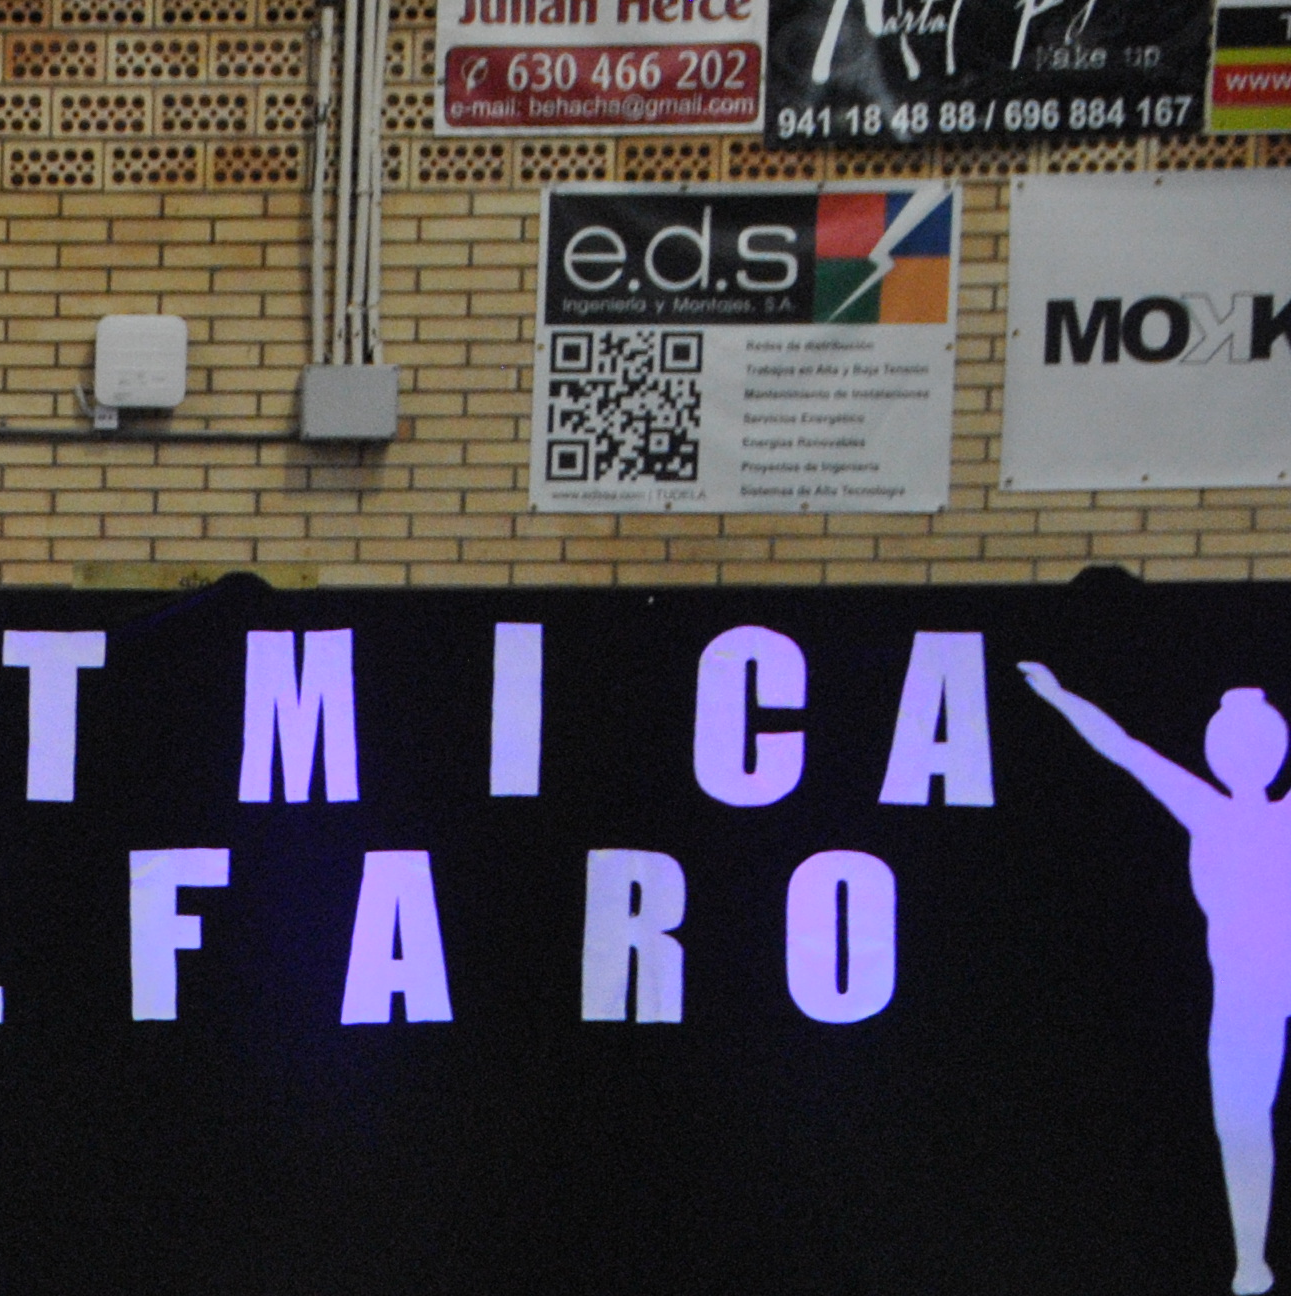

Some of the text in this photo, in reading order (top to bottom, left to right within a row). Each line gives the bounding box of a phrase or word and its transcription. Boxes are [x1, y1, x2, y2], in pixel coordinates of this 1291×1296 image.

[507, 49, 747, 92] 630 466 202
[777, 107, 832, 139] 941
[845, 104, 882, 136] 18
[890, 103, 929, 134] 48
[939, 101, 977, 131] 88
[1004, 99, 1059, 131] 696
[1069, 97, 1125, 129] 884
[1136, 95, 1193, 126] 167
[563, 204, 799, 292] e.d.s
[655, 299, 666, 314] y
